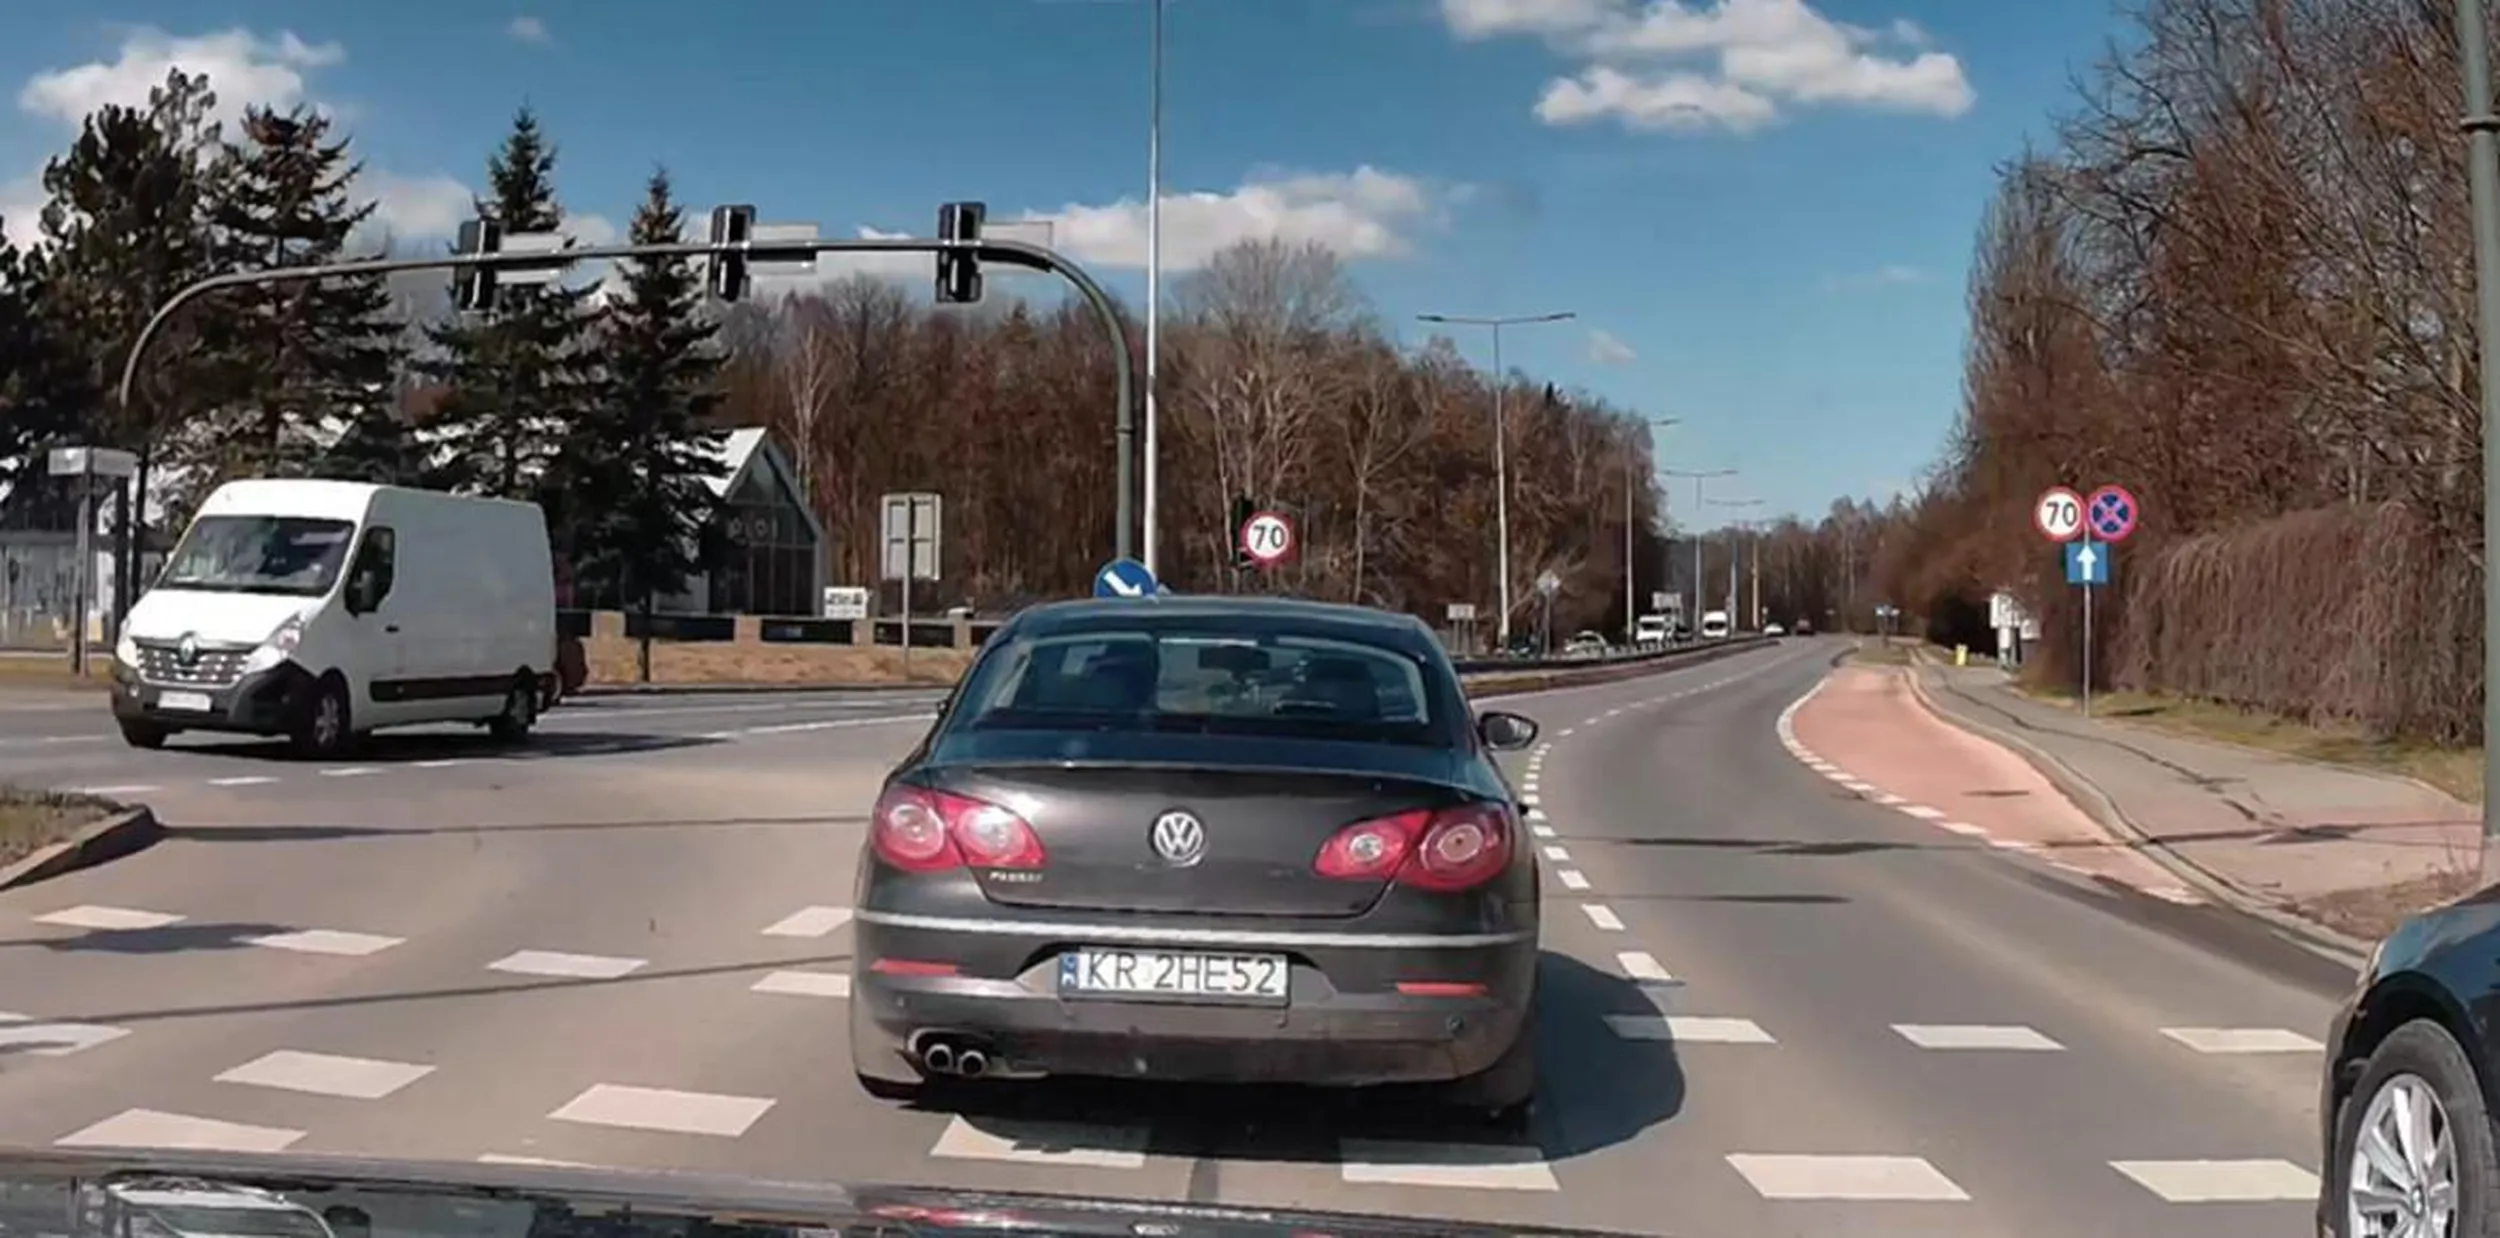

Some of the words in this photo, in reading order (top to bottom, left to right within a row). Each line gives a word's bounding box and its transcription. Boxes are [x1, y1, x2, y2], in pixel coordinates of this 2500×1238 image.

[2046, 501, 2078, 527] 70
[1253, 525, 1286, 550] 70
[1087, 952, 1137, 989] KR
[1153, 954, 1276, 994] 2HE52
